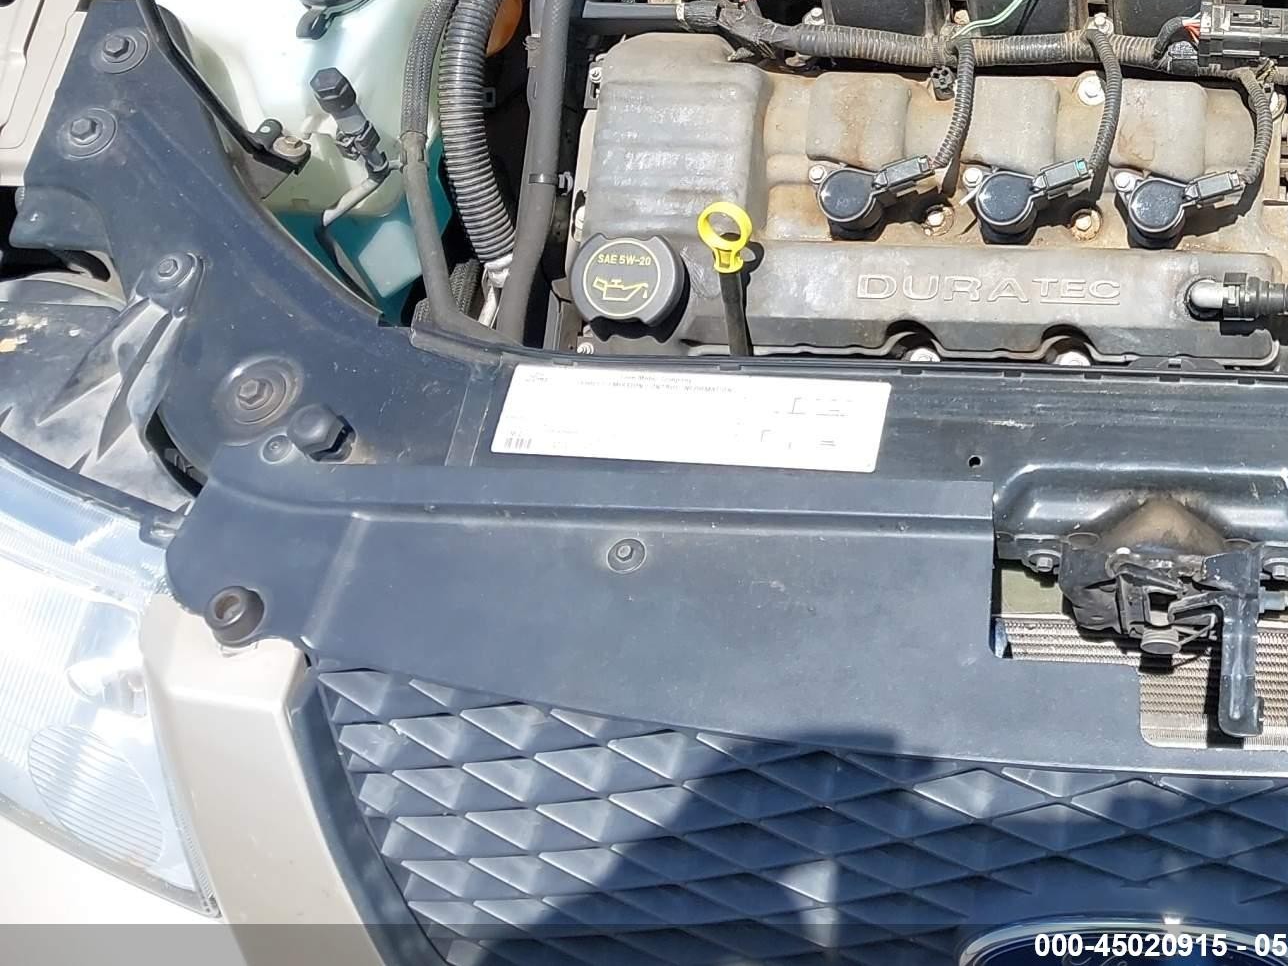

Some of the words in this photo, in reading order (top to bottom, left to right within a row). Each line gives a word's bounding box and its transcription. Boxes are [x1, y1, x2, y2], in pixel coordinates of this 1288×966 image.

[598, 254, 616, 264] SAE
[620, 255, 651, 266] 5W-20
[857, 274, 1120, 304] DURATEC
